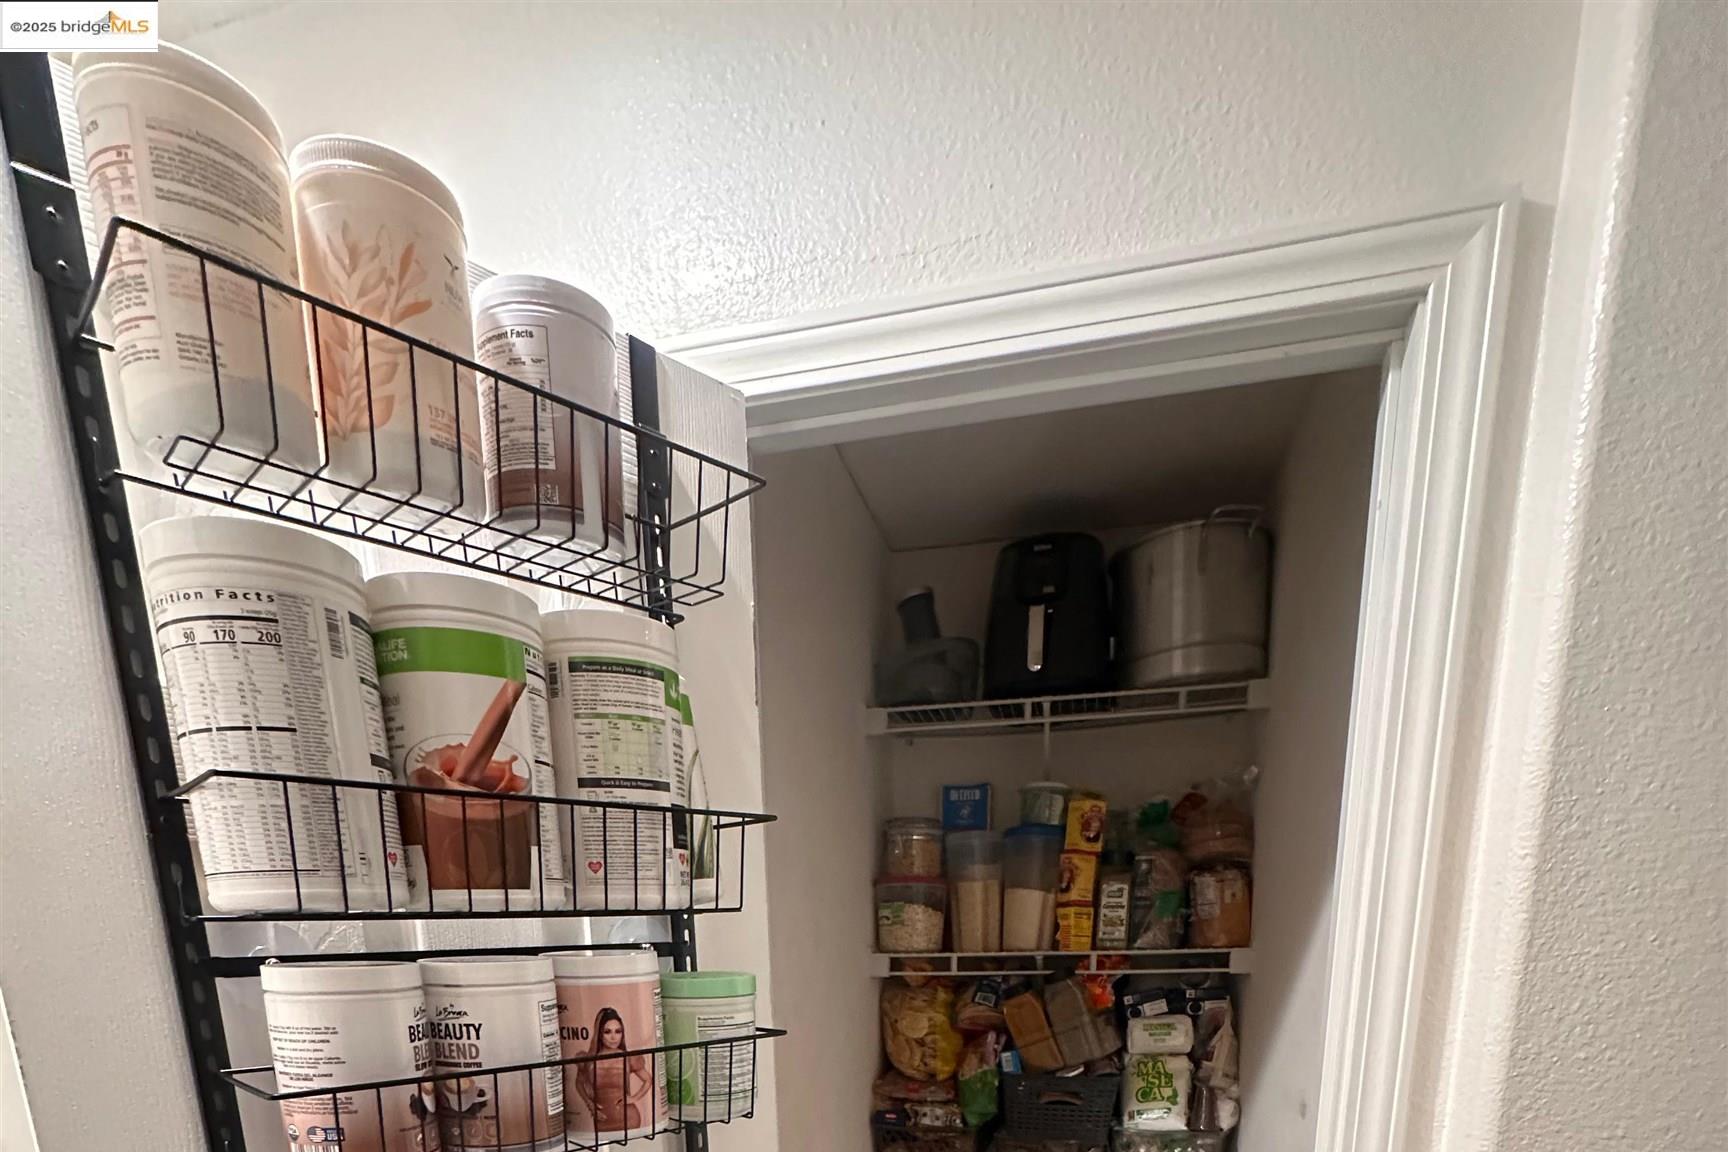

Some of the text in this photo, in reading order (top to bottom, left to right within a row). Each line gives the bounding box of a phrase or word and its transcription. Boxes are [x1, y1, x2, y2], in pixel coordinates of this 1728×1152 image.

[510, 328, 535, 339] Facts
[214, 588, 275, 603] Facts
[183, 630, 196, 643] 90
[213, 629, 236, 641] 170
[257, 630, 282, 644] 200
[430, 1021, 483, 1041] BEAUTY
[560, 1026, 589, 1041] CINO
[435, 1041, 480, 1061] BLEND
